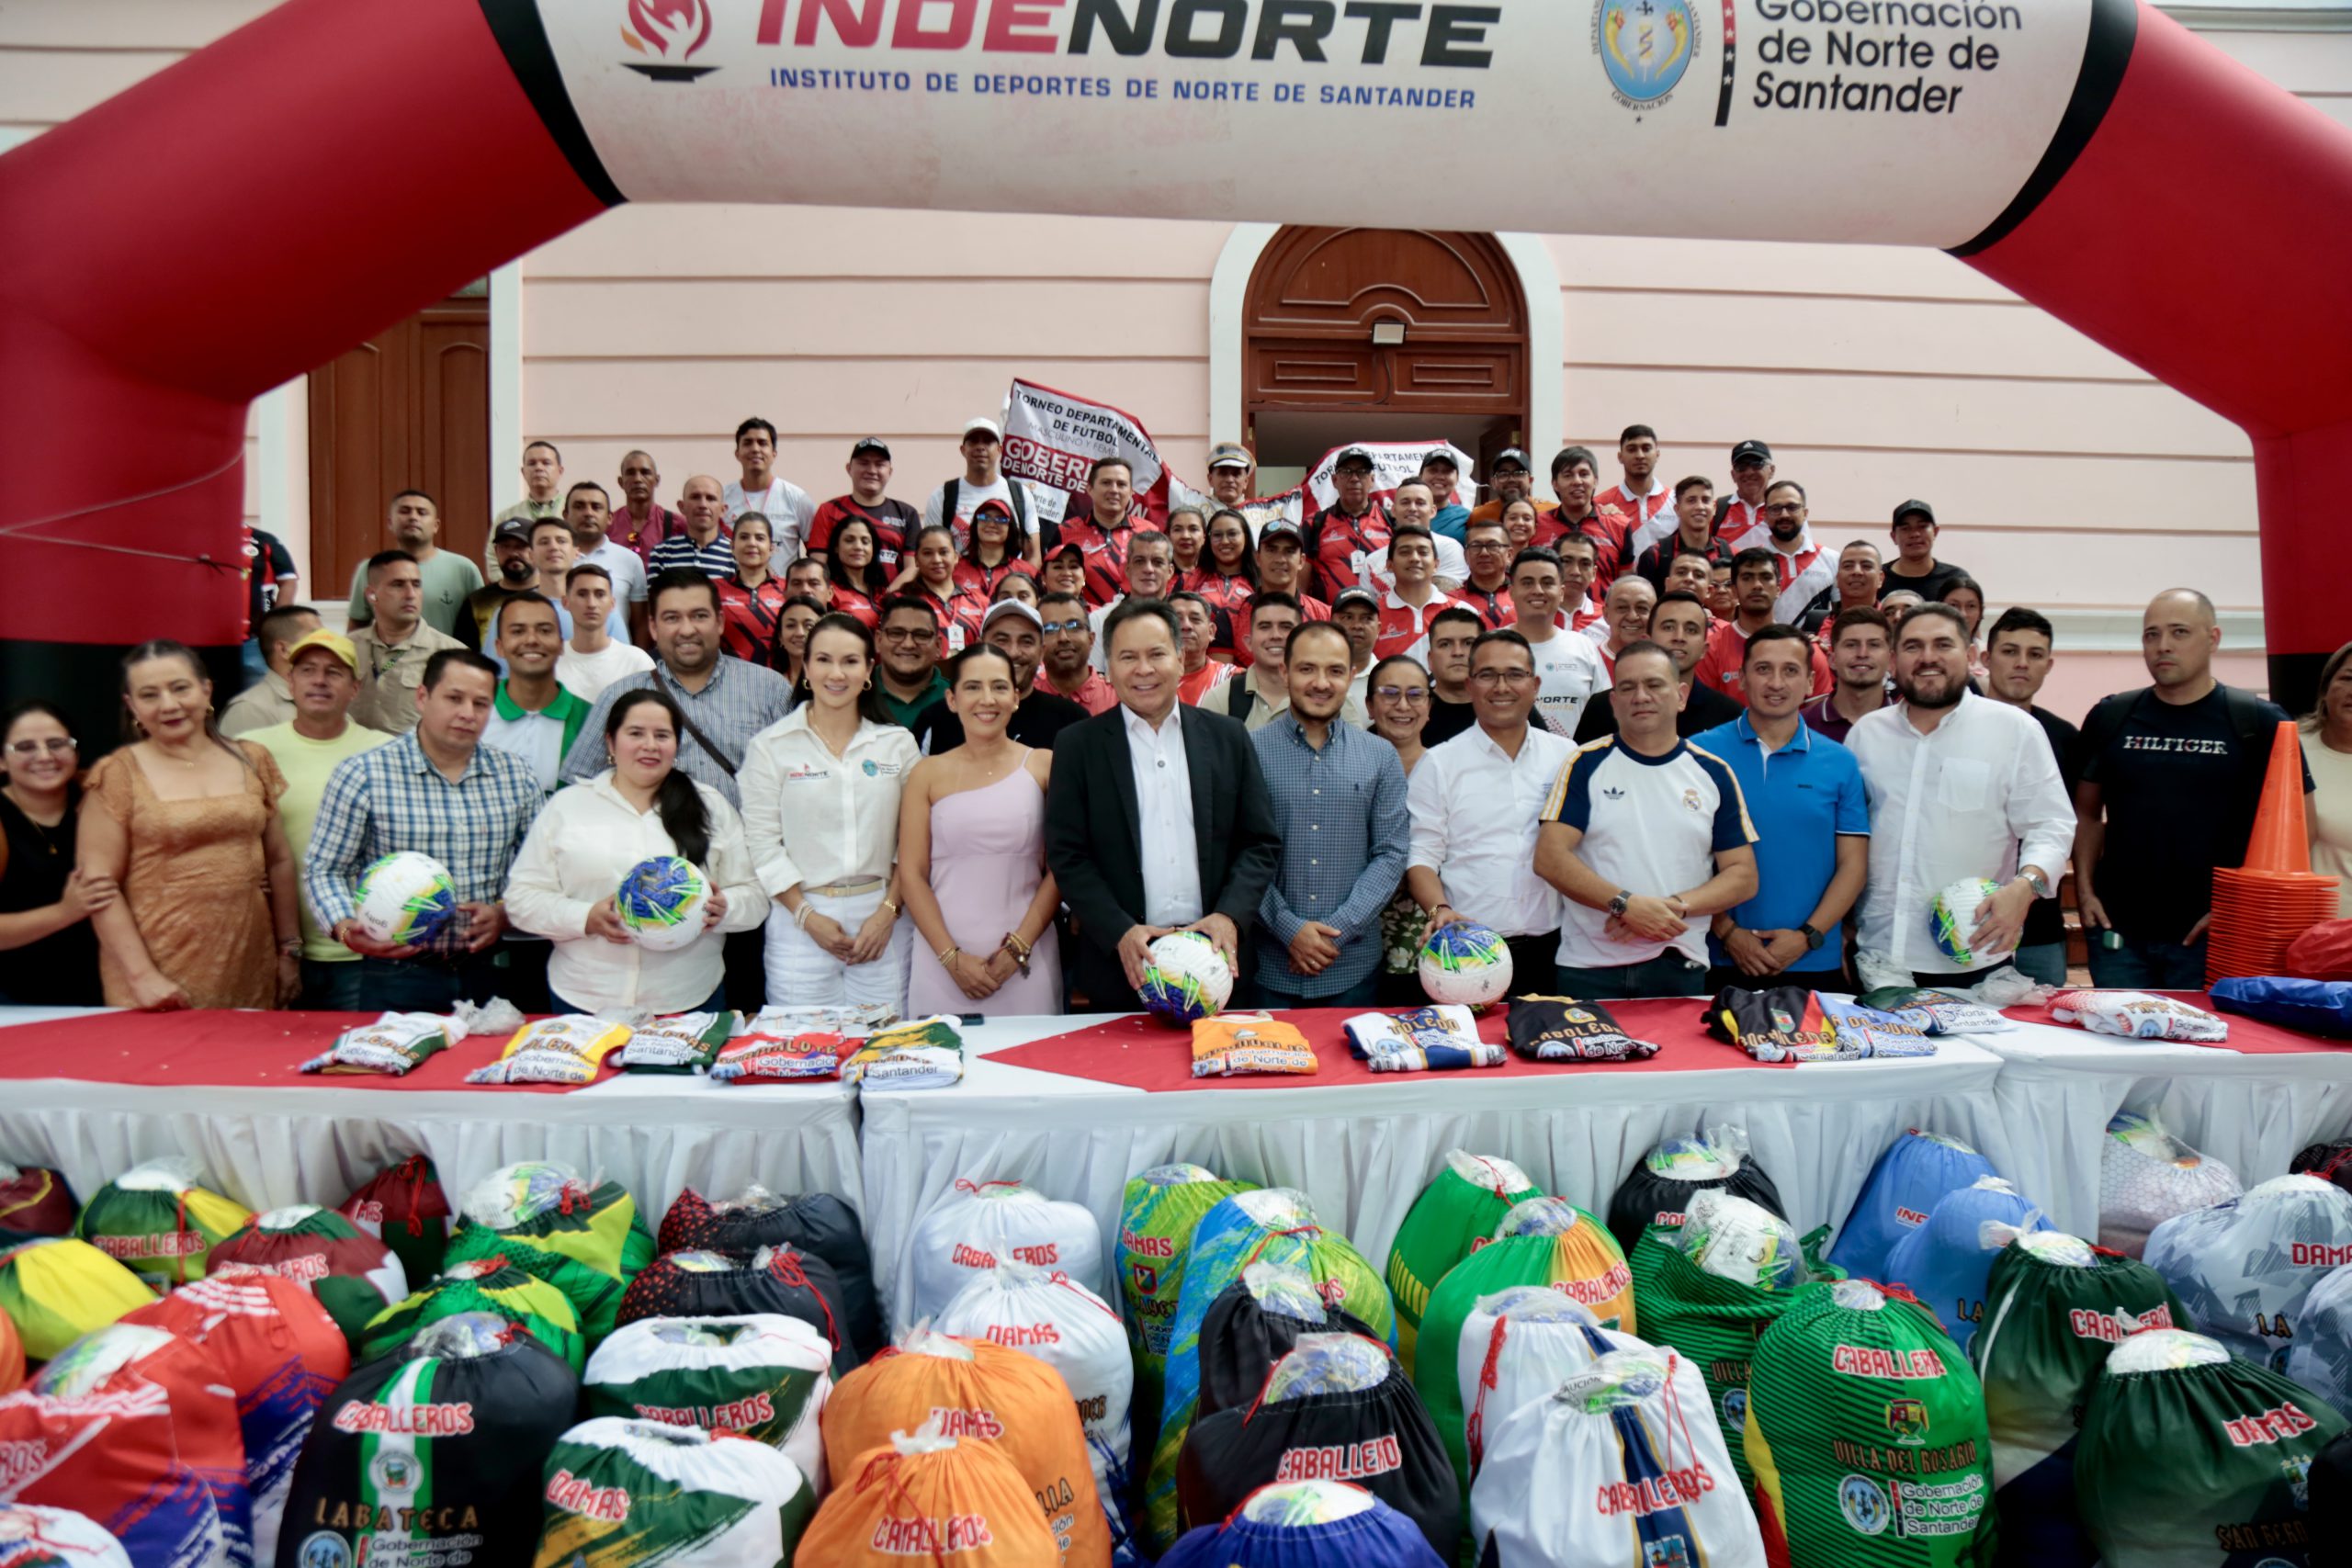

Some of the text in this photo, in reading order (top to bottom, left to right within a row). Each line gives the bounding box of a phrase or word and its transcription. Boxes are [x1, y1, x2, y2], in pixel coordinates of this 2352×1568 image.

[1757, 0, 2021, 29] Gobernación
[756, 0, 1502, 69] INDENORTE
[1758, 28, 1999, 71] de Norte de
[771, 68, 1476, 108] INSTITUTO DE DEPORTES DE NORTE DE SANTANDER
[1753, 70, 1963, 114] Santander
[1016, 389, 1160, 464] TORNEO DEPARTAMENTAL
[1053, 419, 1069, 433] DE
[1005, 438, 1093, 482] GOBER
[1092, 442, 1119, 457] FEME
[1021, 460, 1065, 488] NORTE
[1067, 478, 1089, 494] DE
[1535, 695, 1578, 705] ORTE
[2122, 735, 2229, 755] HILFIGER
[1387, 1017, 1462, 1035] TOLEDO
[533, 1066, 567, 1079] Norte
[570, 1071, 587, 1081] de
[1233, 1055, 1308, 1067] de Norte de
[1123, 1226, 1174, 1258] DAMAS
[985, 1322, 1060, 1347] DAMAS
[2256, 1312, 2294, 1339] LA
[332, 1400, 475, 1437] CABALLEROS
[2222, 1400, 2318, 1448] DAMAS
[1833, 1438, 1977, 1474] VILLA DEL ROSARIO
[546, 1467, 632, 1522] DAMAS
[1902, 1474, 1984, 1498] Gobernación
[315, 1496, 479, 1531] LABATECA
[1905, 1494, 1984, 1516] de Norte de
[1906, 1517, 1980, 1535] Santander
[371, 1533, 483, 1551] Gobernación
[368, 1551, 473, 1568] de Norte de
